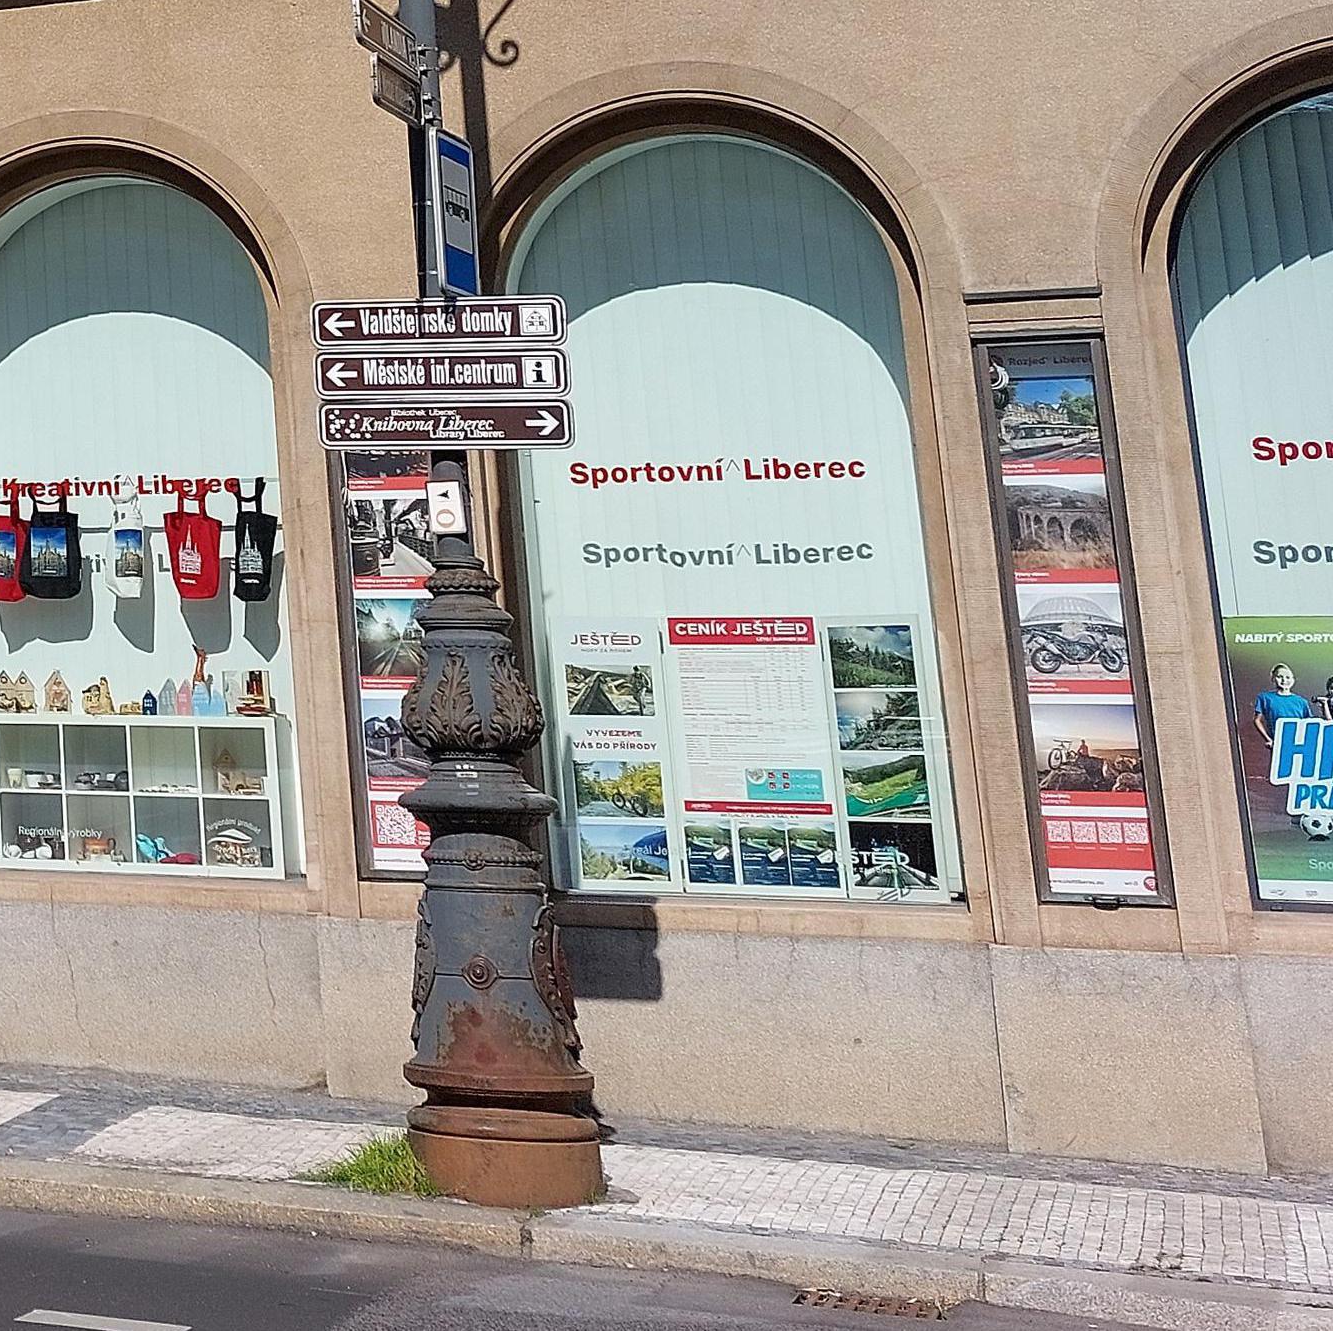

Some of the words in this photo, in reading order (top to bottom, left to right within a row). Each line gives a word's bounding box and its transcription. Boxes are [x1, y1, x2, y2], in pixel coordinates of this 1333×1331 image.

[461, 306, 512, 336] domky
[363, 357, 426, 386] Městské
[360, 417, 433, 432] Knihovna
[438, 416, 494, 431] Liberec
[430, 430, 465, 439] Library
[467, 429, 505, 438] Liberec
[569, 458, 723, 488] Sportovní
[743, 458, 866, 481] Liberec
[2, 474, 122, 498] Kreativní
[675, 623, 727, 636] CENÍK
[733, 620, 808, 635] JEŠTĚD
[570, 631, 642, 646] JEŠTĚD
[1235, 632, 1284, 643] NABITÝ
[573, 741, 593, 749] VÁS
[613, 741, 657, 750] PŘÍRODY
[18, 826, 67, 838] Regionáln
[66, 828, 102, 840] ýrobky
